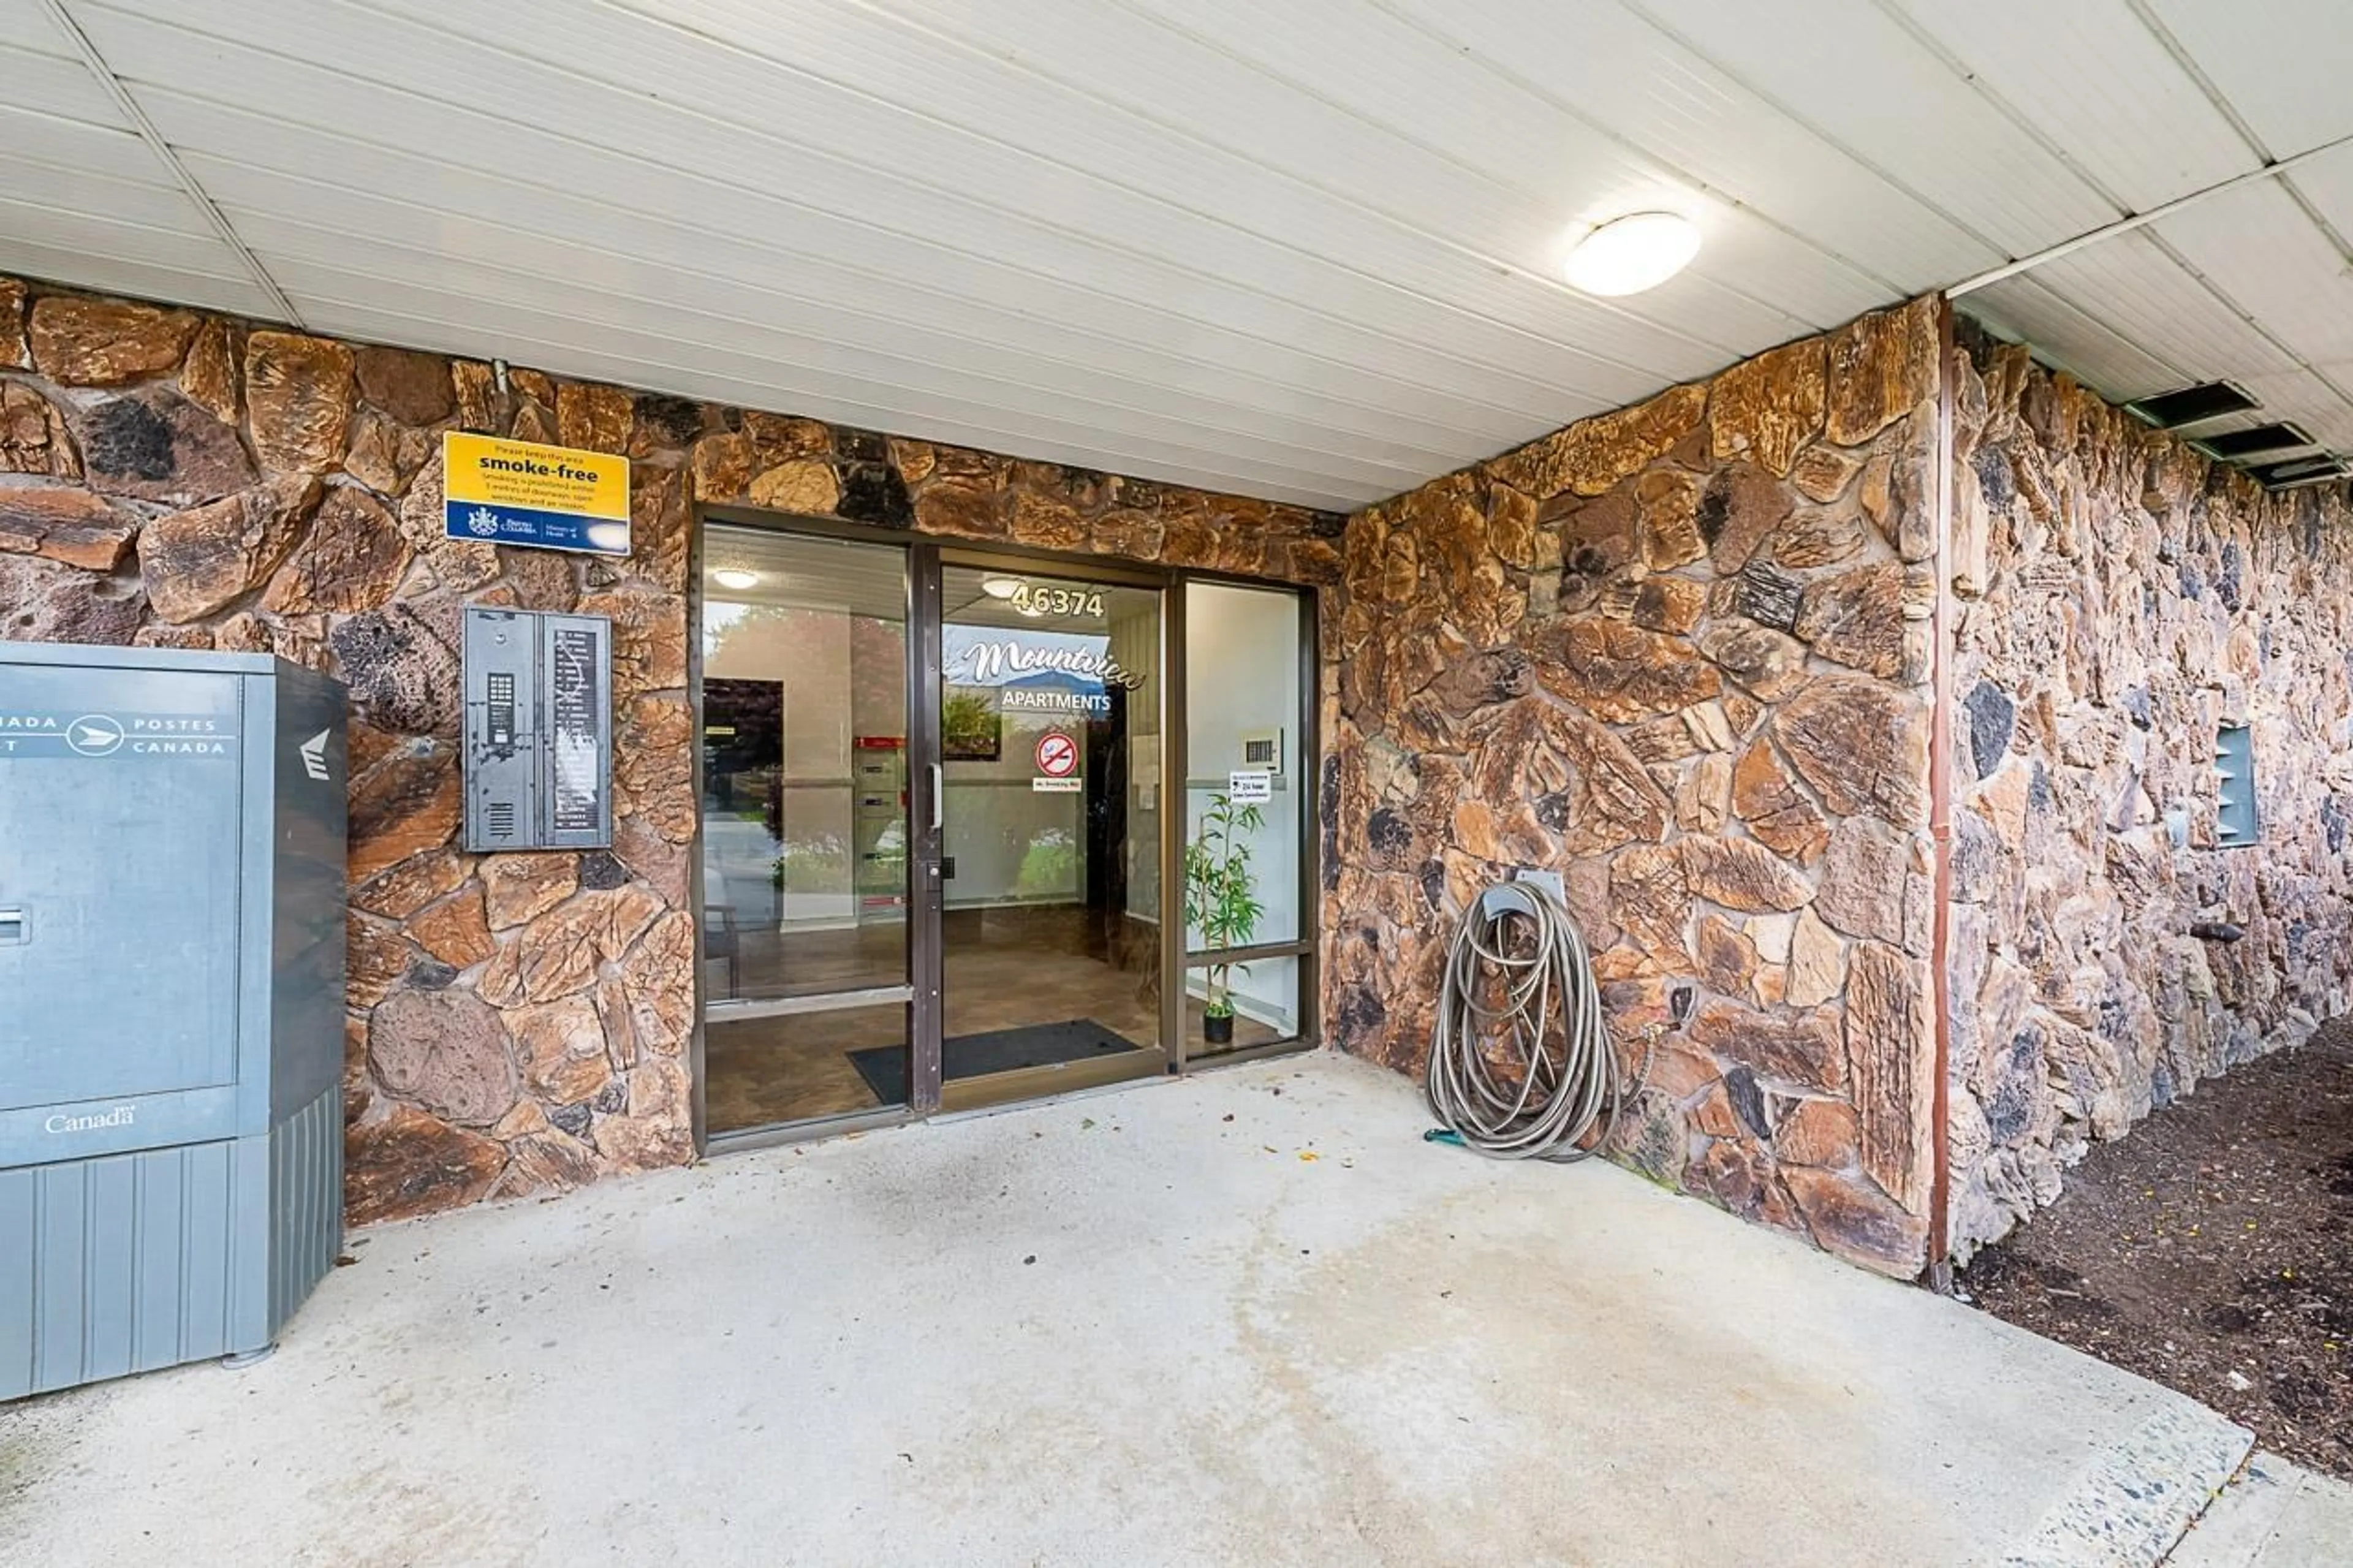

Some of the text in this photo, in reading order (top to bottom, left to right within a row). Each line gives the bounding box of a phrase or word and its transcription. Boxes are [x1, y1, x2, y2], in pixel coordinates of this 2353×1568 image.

[480, 457, 598, 482] smoke-free
[1011, 585, 1104, 617] 46374
[963, 642, 1146, 691] Mountview
[1002, 691, 1112, 711] APARTMENTS
[0, 716, 56, 728] ADA
[134, 719, 216, 731] POSTES
[132, 742, 225, 754] CANADA
[45, 1105, 134, 1134] Canada
